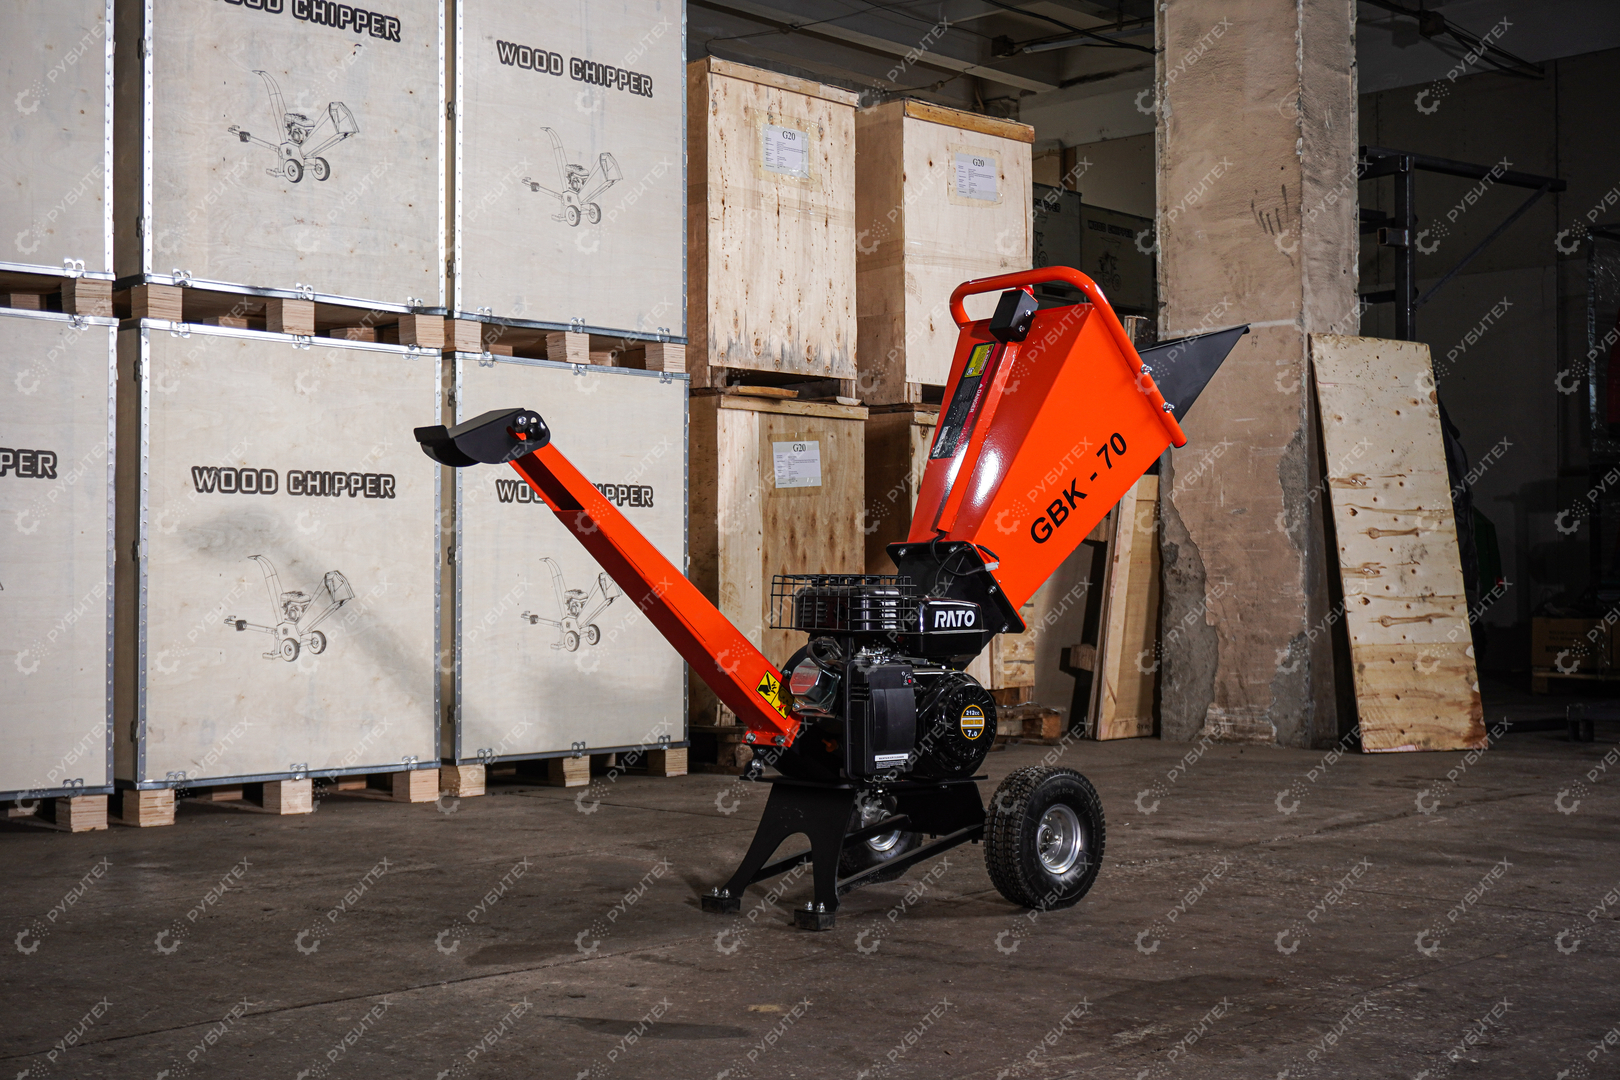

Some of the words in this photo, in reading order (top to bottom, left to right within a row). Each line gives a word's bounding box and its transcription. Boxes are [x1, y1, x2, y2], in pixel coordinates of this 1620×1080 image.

[496, 40, 564, 77] WOOD
[570, 57, 654, 98] CHIPPER
[782, 130, 796, 141] G20
[972, 158, 985, 168] G20
[792, 443, 807, 453] G20
[0, 448, 57, 480] PER
[191, 466, 279, 495] WOOD
[286, 470, 397, 500] CHIPPER
[495, 479, 547, 504] WO
[592, 482, 654, 508] PPER
[1030, 477, 1088, 544] GBK
[1096, 432, 1127, 470] 70
[934, 610, 976, 628] RATO
